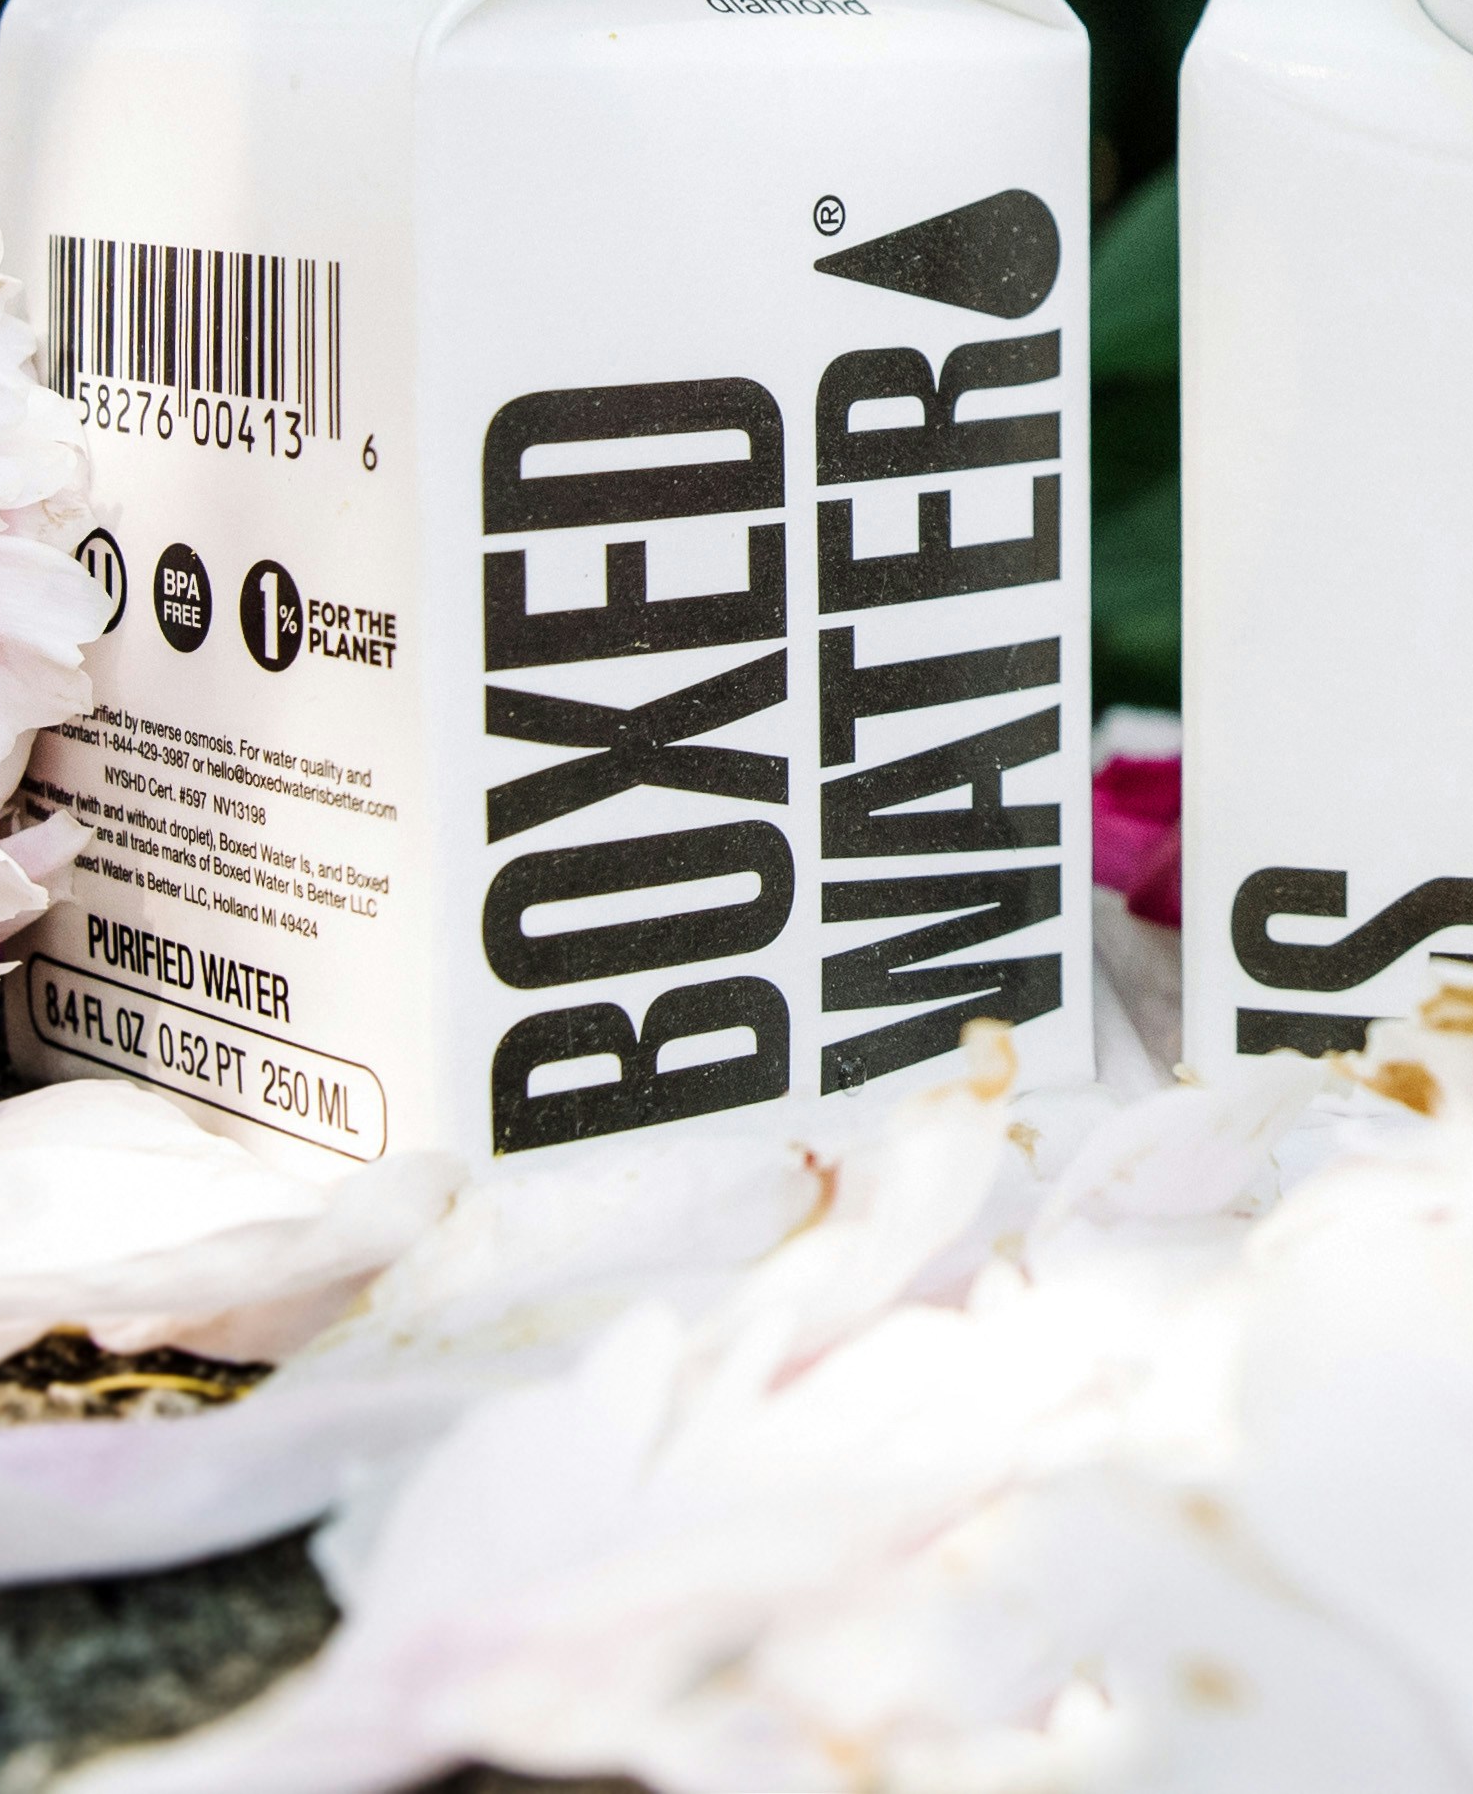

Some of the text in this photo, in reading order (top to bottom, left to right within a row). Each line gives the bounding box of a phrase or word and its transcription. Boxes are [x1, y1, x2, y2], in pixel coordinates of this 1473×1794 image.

[79, 381, 378, 472] 58276 00413 6
[162, 567, 201, 602] BPA
[162, 599, 203, 630] FREE
[308, 598, 398, 640] FOR THE
[308, 626, 398, 669] PLANET
[125, 710, 139, 736] by
[140, 717, 182, 743] reverse
[184, 729, 237, 756] osmosis.
[240, 739, 260, 761] For
[262, 748, 298, 770] water
[300, 757, 344, 786] quality
[346, 768, 373, 789] and
[815, 327, 1064, 1097] WATER
[61, 723, 399, 822] contact 1-844-429-3987 or hello@boxedwaterisbetter.com
[104, 764, 267, 827] NYSHD Cert. #597 NV13198
[481, 376, 796, 1159] BOXED
[76, 790, 102, 816] (with
[103, 803, 125, 823] and
[126, 808, 168, 836] without
[170, 821, 217, 852] droplet),
[219, 831, 258, 860] Boxed
[259, 842, 297, 870] Water
[299, 853, 315, 879] Is,
[317, 862, 344, 883] and
[346, 866, 390, 896] Boxed
[96, 825, 379, 919] are all trade marks of Boxed Water Is Better LLC
[74, 853, 100, 875] oxed
[100, 857, 134, 885] Water
[146, 871, 182, 899] Better
[184, 883, 211, 911] LLC,
[212, 890, 259, 923] Holland
[261, 905, 278, 928] MI
[279, 911, 319, 940] 49424
[87, 912, 292, 1025] PURIFIED WATER
[44, 980, 360, 1137] 8.4 FL OZ 0.52 PT 250 ML
